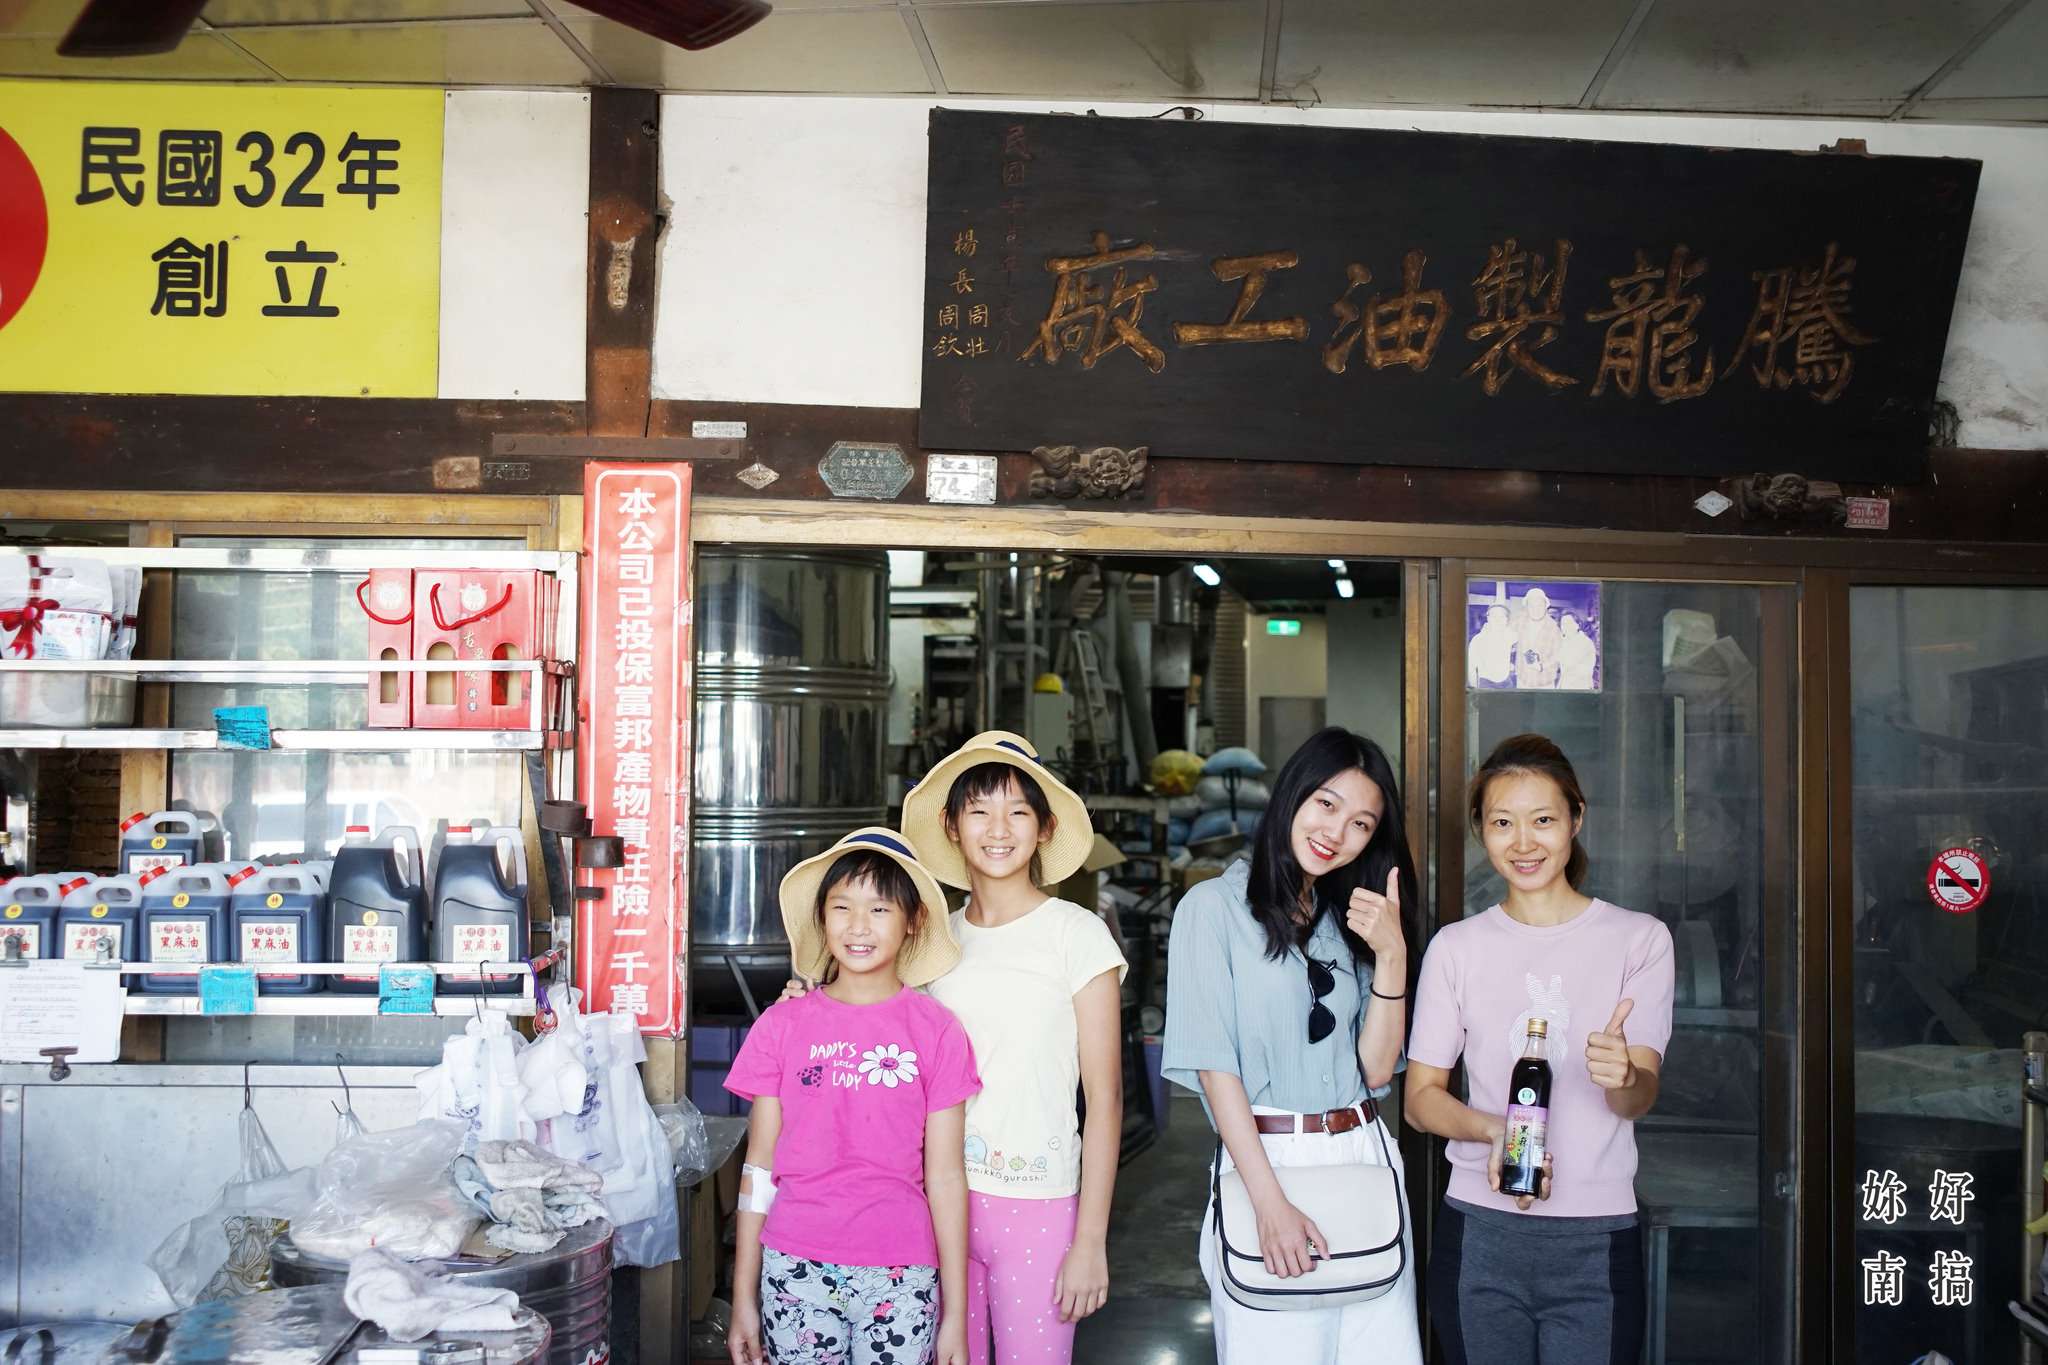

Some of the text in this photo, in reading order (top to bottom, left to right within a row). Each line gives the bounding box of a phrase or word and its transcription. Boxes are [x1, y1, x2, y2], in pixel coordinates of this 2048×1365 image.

[75, 126, 401, 211] 民國32年
[150, 235, 345, 318] 創立
[809, 1040, 857, 1060] DADDY'S
[832, 1069, 863, 1092] LADY
